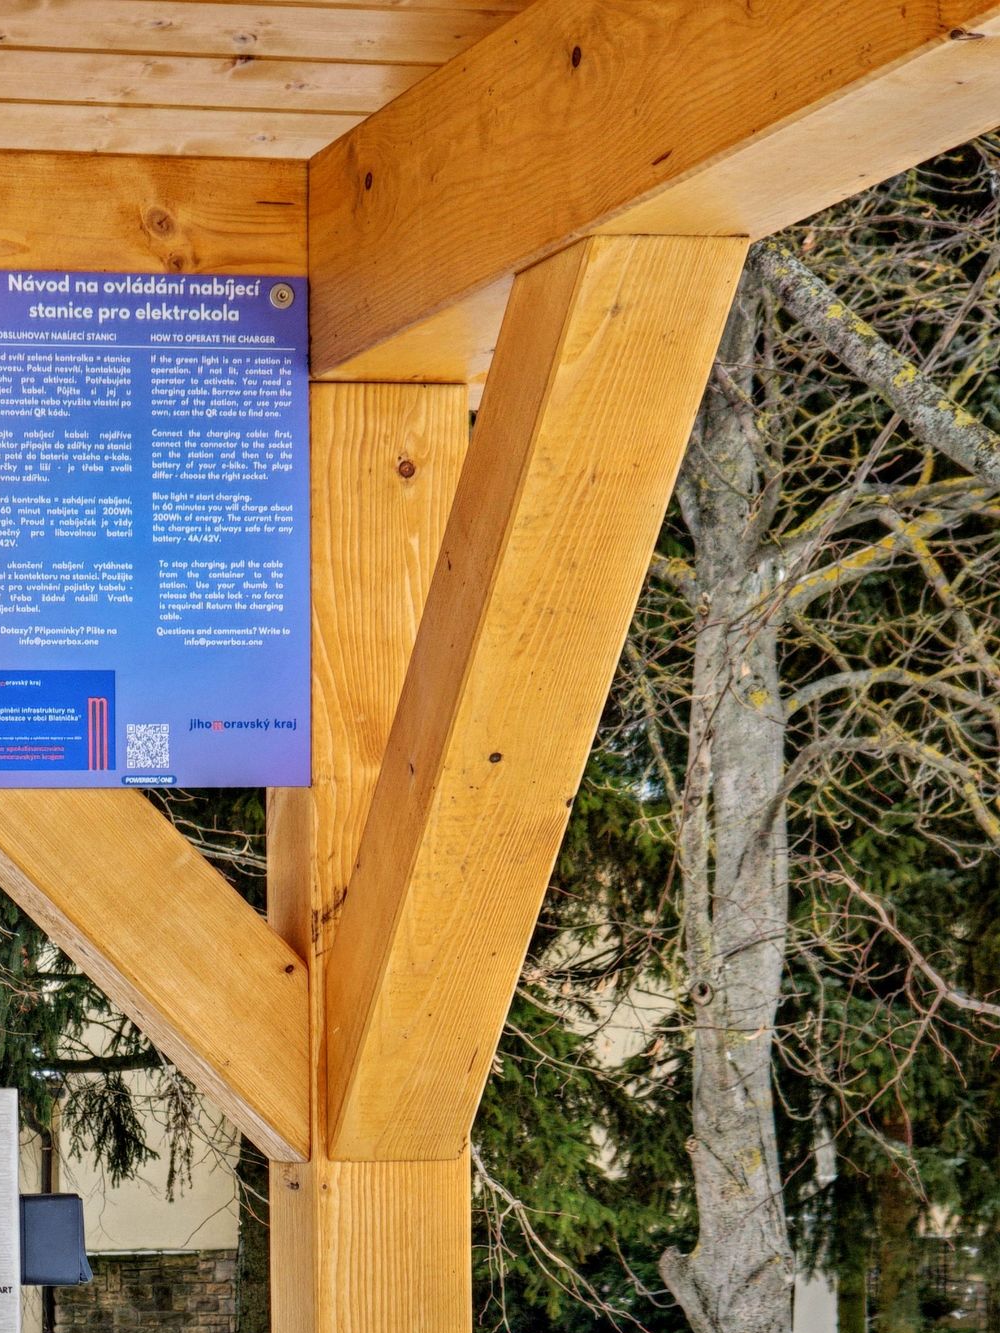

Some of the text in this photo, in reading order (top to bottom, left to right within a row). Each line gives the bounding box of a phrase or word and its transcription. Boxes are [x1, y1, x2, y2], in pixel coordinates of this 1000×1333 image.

[8, 274, 260, 300] Návod na ovládání nabíjecí
[29, 301, 239, 323] stanice pro elektrokola
[51, 332, 85, 340] NABÍJECÍ
[86, 332, 117, 341] STANICI
[150, 334, 275, 343] HOW TO OPERATE THE CHARGER
[34, 408, 46, 418] QR
[205, 408, 218, 418] QR
[157, 626, 195, 637] Questions
[274, 718, 297, 731] kraj
